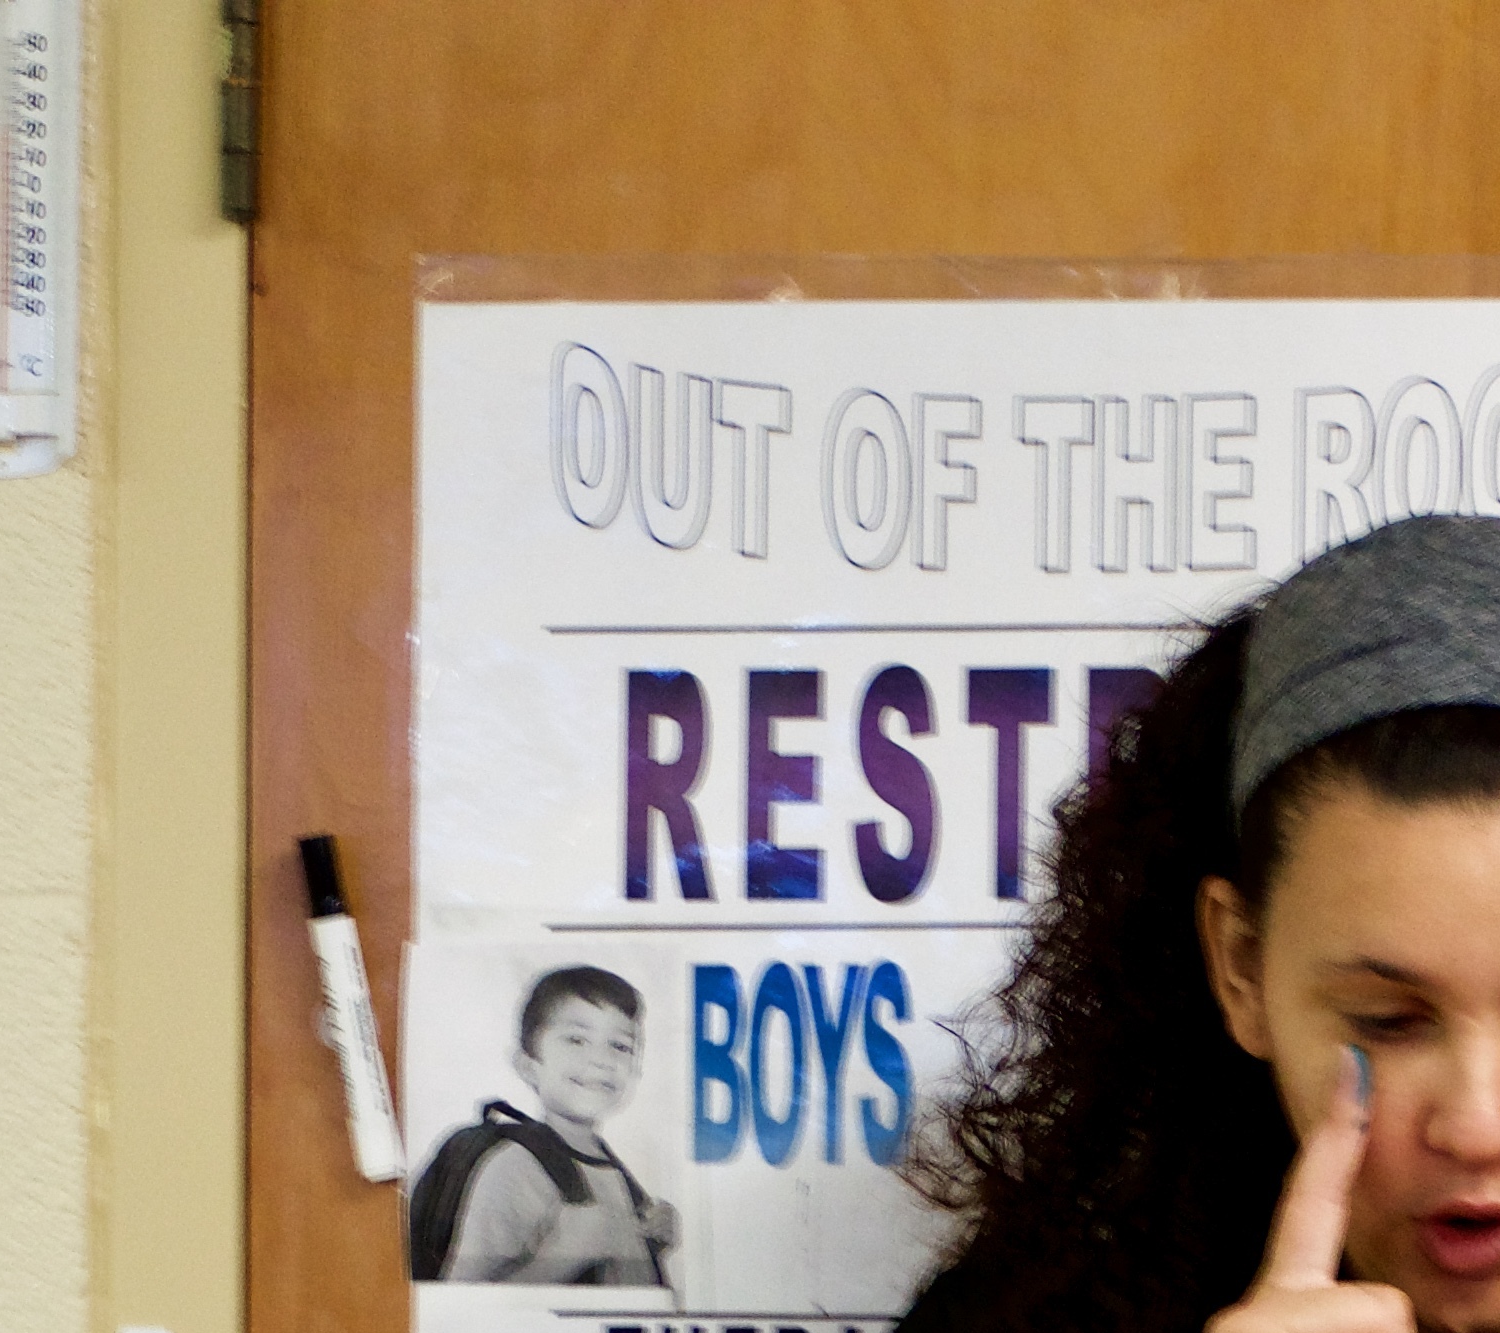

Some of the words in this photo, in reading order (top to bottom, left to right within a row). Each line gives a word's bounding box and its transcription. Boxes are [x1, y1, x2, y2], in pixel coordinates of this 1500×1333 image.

[550, 340, 792, 558] OUT
[822, 387, 982, 571] OF
[1013, 394, 1257, 573] THE
[688, 958, 915, 1169] BOYS
